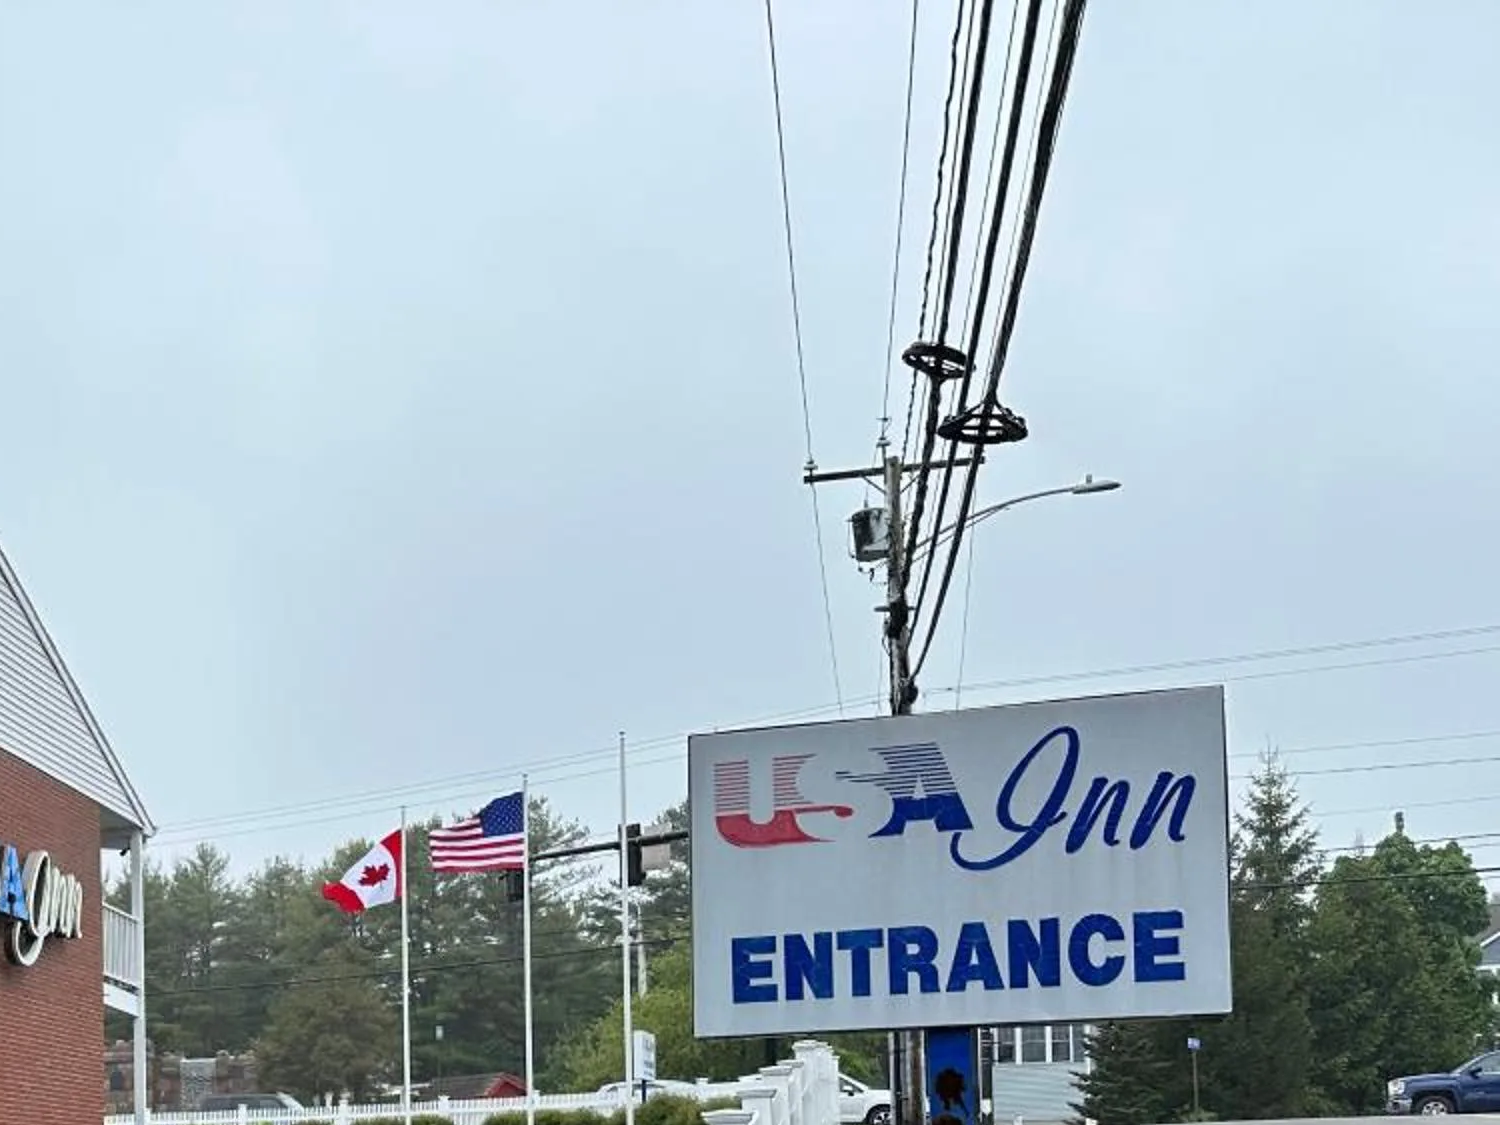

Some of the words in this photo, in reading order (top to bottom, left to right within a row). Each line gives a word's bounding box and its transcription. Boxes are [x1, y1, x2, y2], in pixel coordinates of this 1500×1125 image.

[713, 741, 974, 849] USA
[949, 725, 1197, 871] Inn
[12, 850, 83, 966] Inn
[730, 909, 1186, 1004] ENTRANCE
